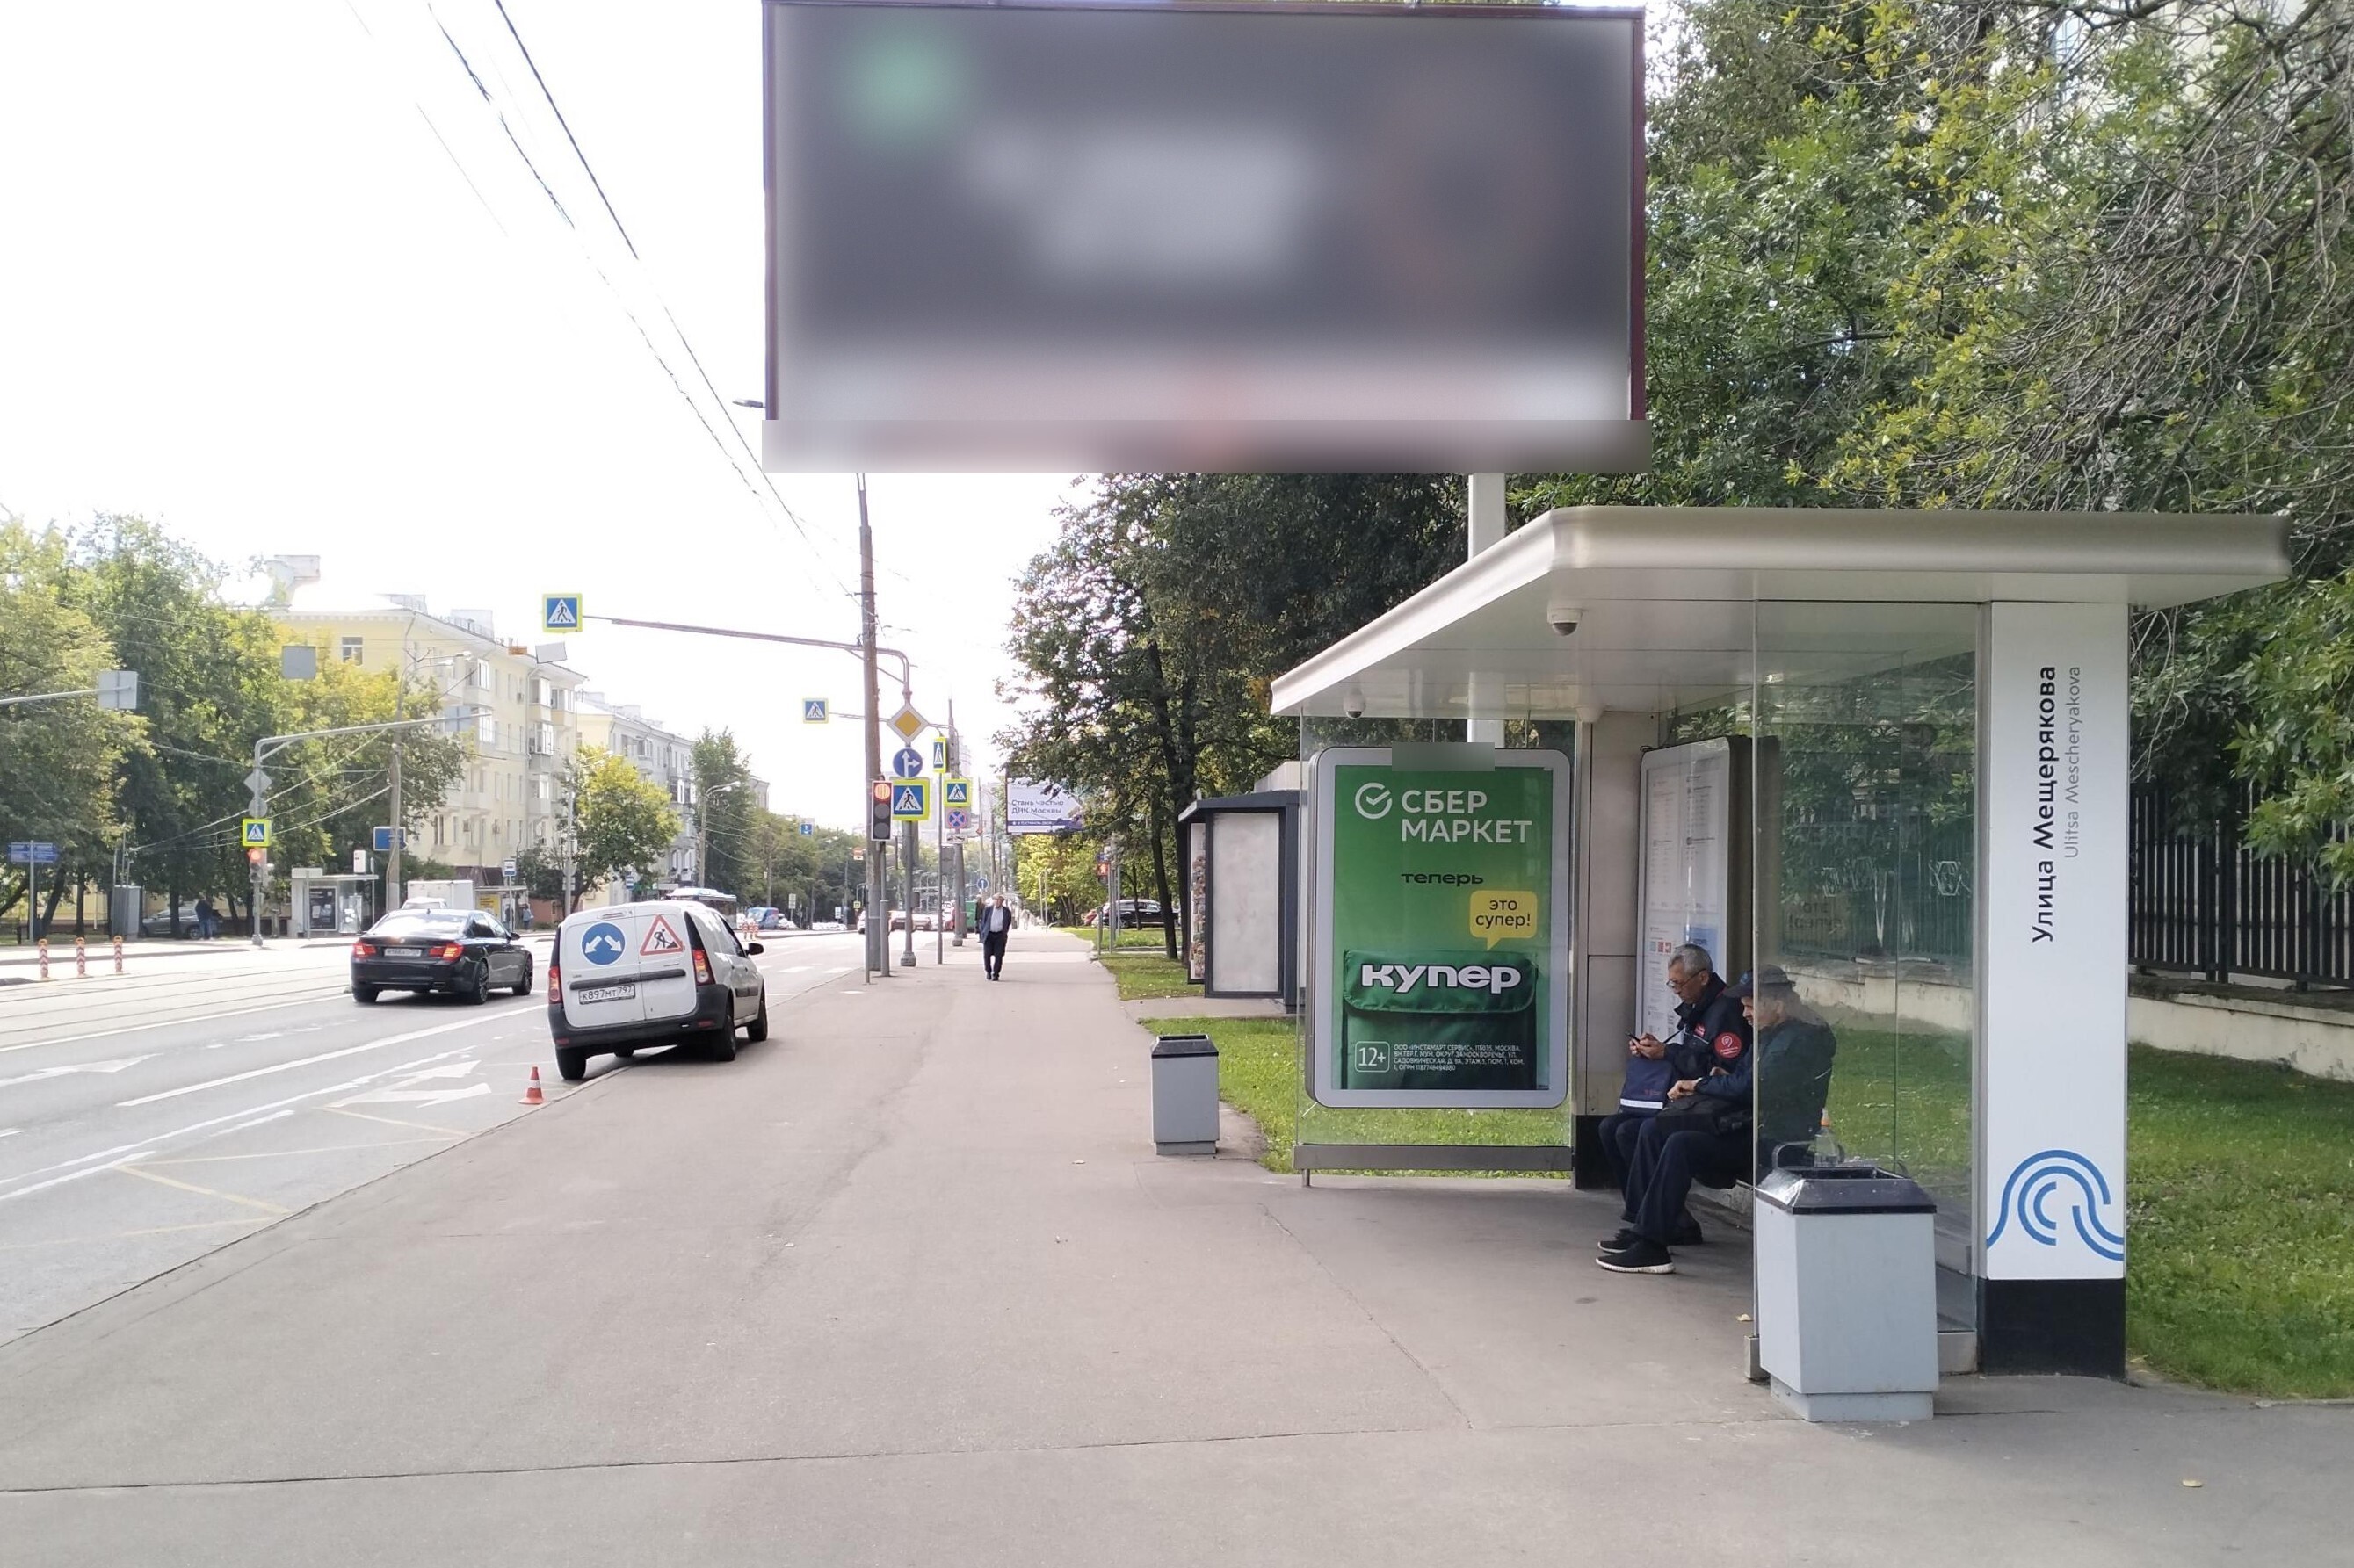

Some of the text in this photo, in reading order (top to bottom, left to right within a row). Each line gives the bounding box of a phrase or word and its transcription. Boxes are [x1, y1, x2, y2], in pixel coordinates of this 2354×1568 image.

[2064, 666, 2082, 858] Ulitsa Mescheryakova
[1401, 790, 1488, 814] СБЕР
[2032, 666, 2059, 943] Улица Мещерякова
[1401, 818, 1532, 844] МАРКЕТ
[1401, 872, 1484, 887] теперь
[1489, 899, 1518, 911] это
[1475, 913, 1531, 930] супер!
[1361, 964, 1522, 994] купер
[1358, 1046, 1387, 1066] 12+
